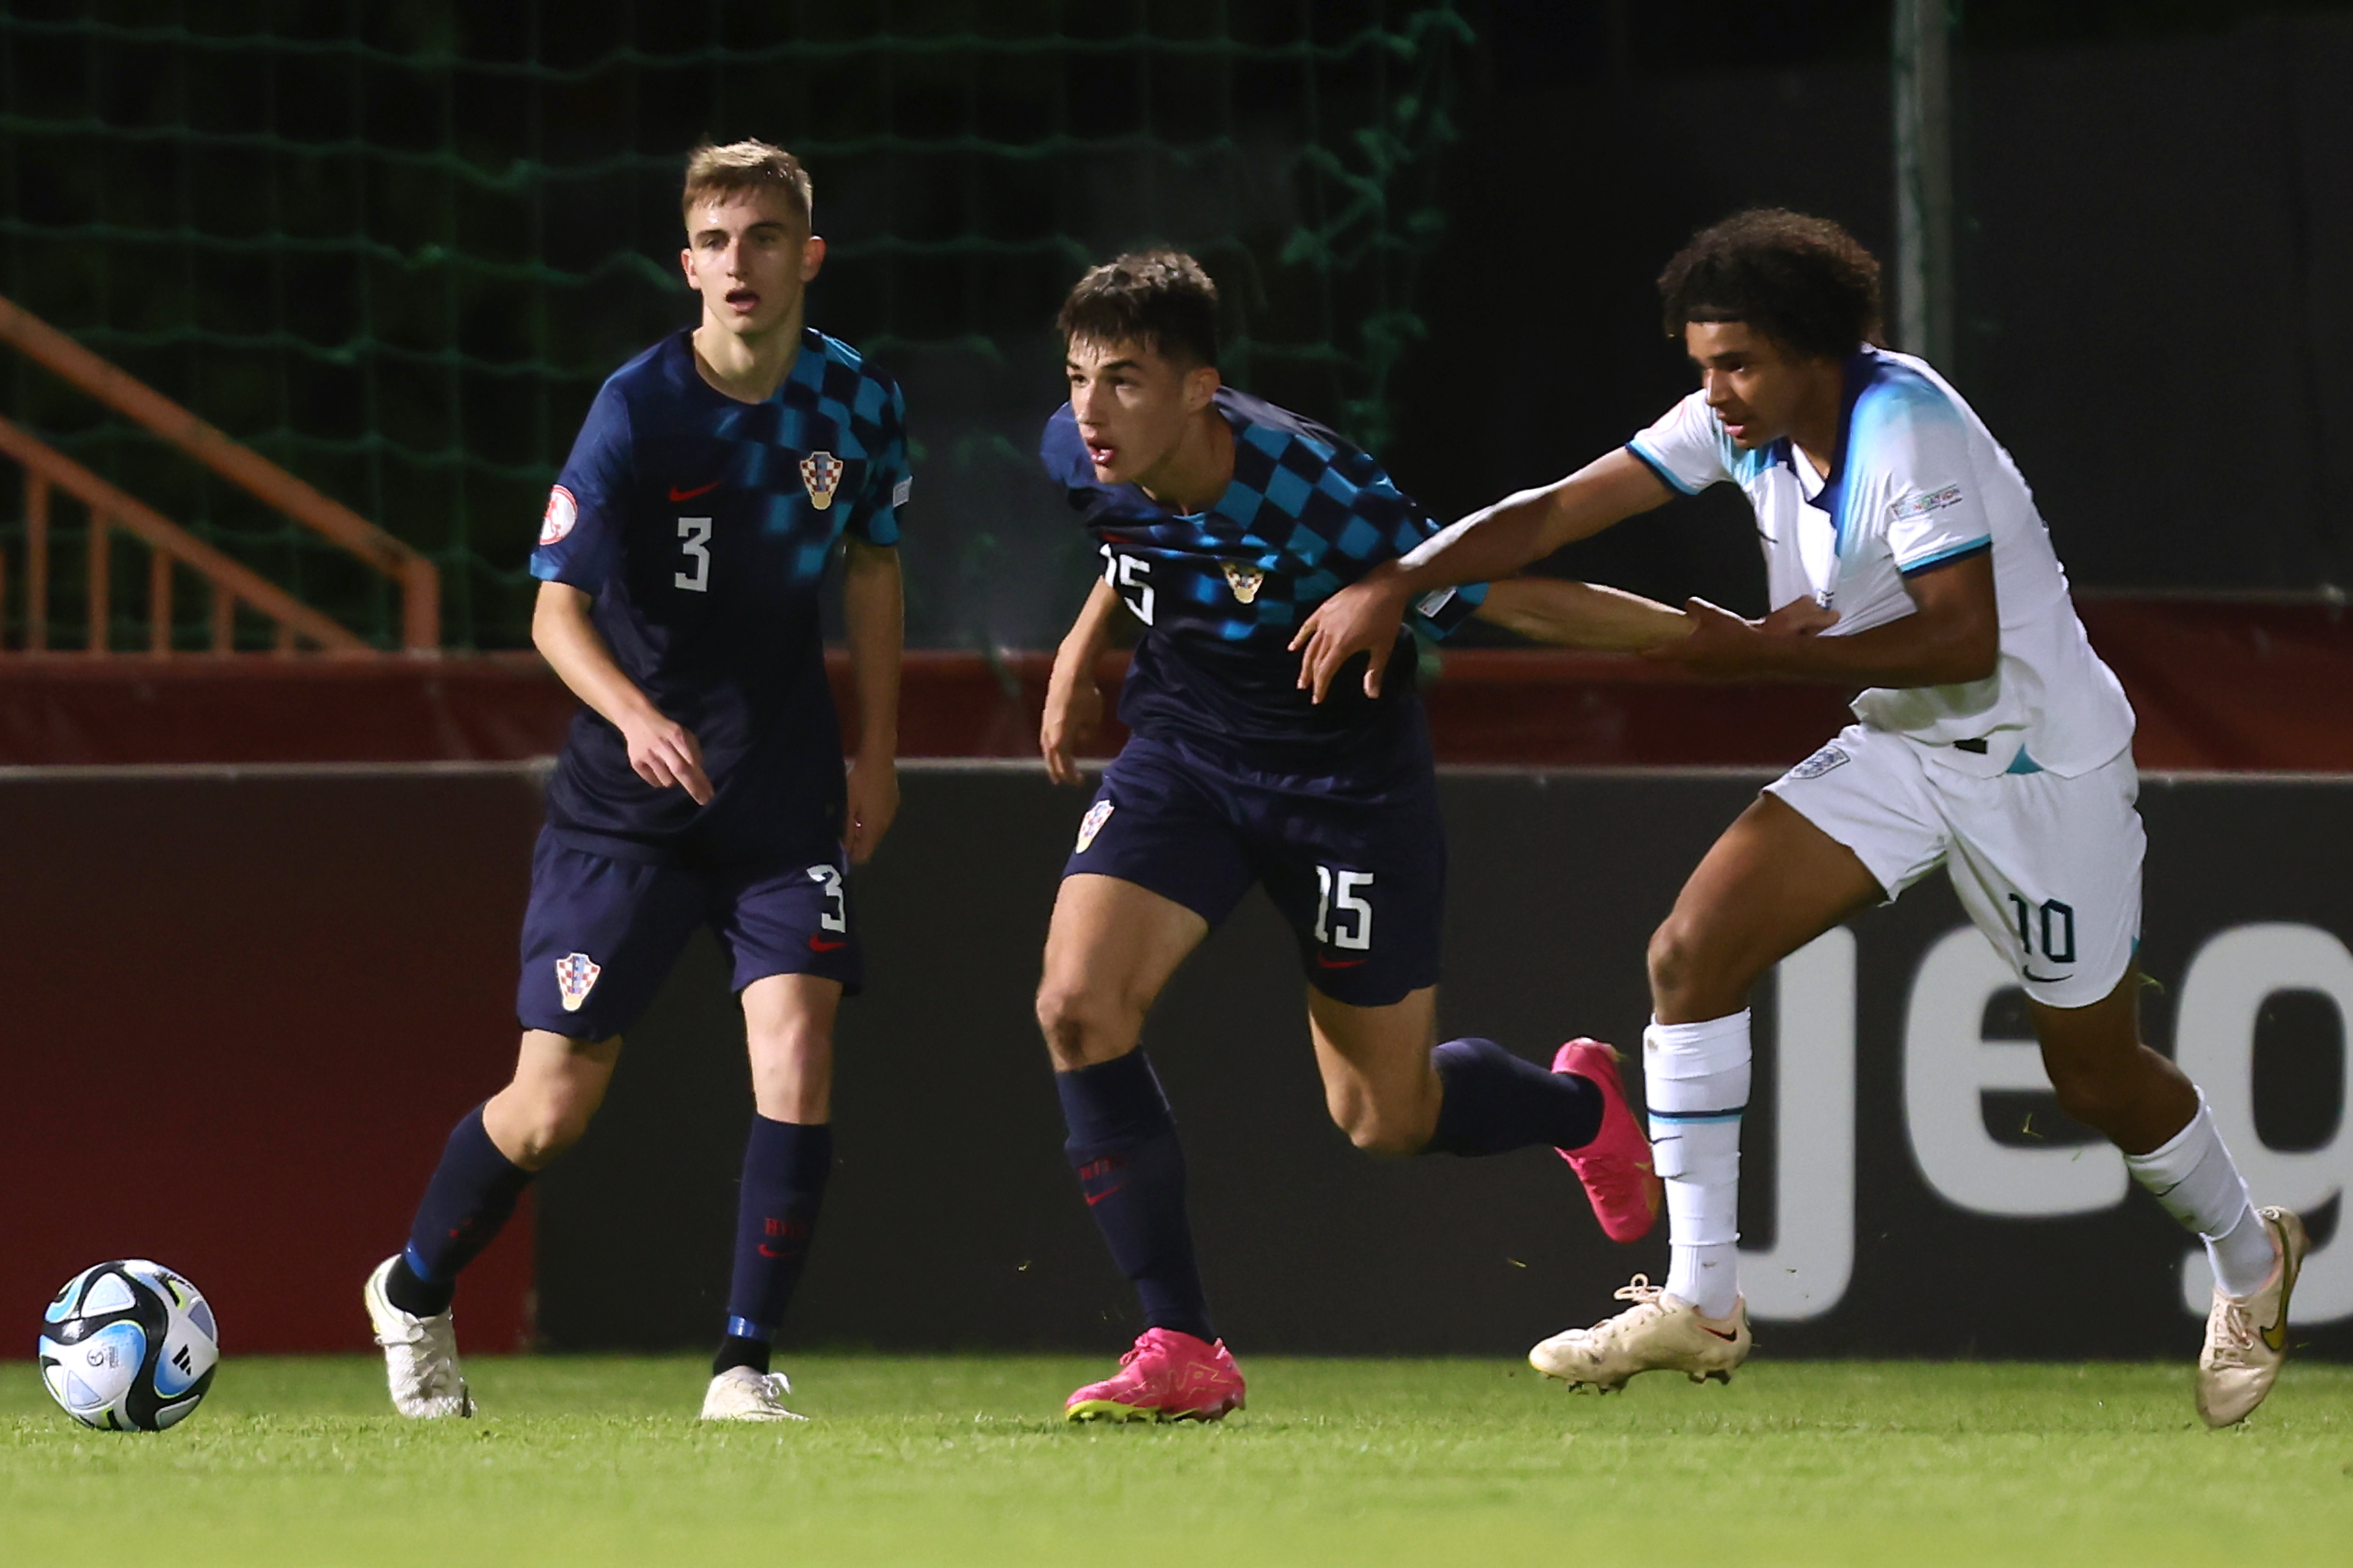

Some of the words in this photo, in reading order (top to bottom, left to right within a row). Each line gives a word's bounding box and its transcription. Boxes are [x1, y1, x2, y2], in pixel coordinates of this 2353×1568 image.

[675, 517, 712, 591] 3
[1100, 543, 1154, 626] 15
[807, 864, 846, 933] 3
[1315, 864, 1374, 950] 15
[2008, 893, 2076, 963] 10
